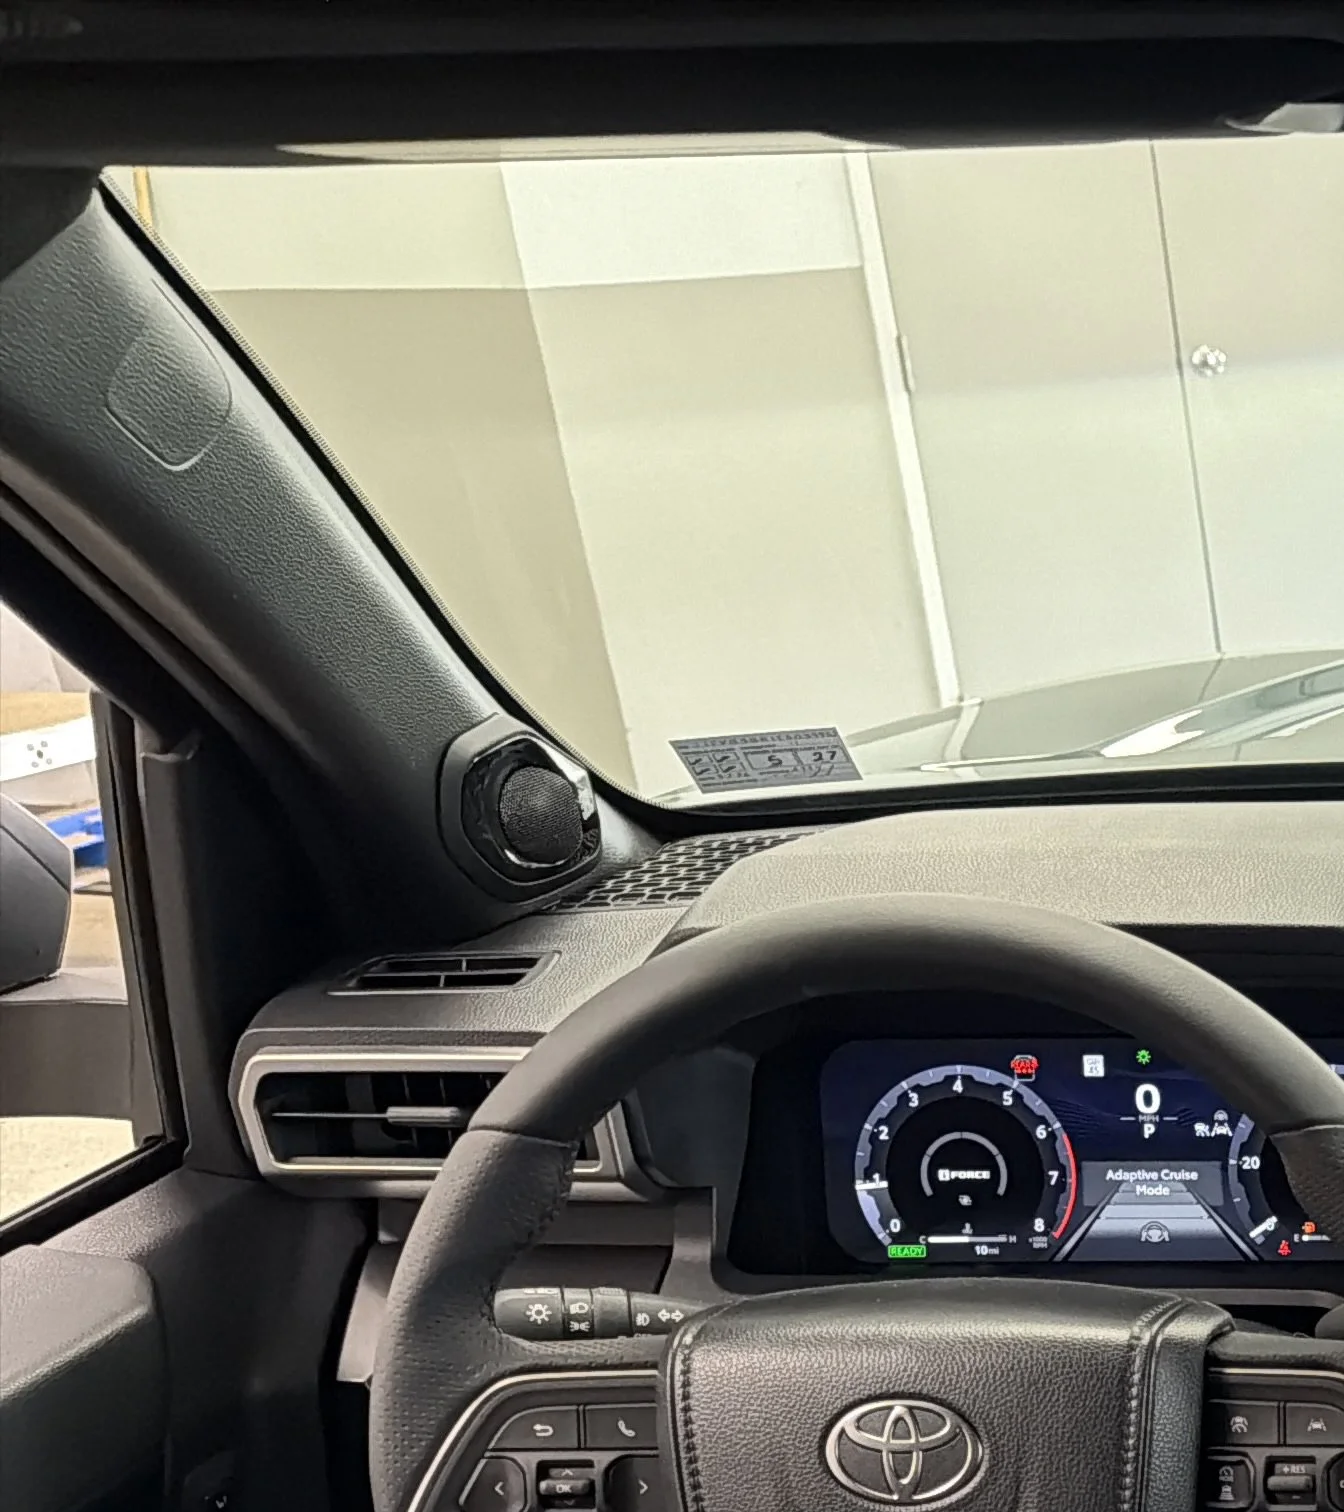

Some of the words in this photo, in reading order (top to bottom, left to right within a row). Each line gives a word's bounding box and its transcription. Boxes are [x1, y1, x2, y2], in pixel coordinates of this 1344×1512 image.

[952, 1079, 964, 1094] 4
[908, 1092, 919, 1108] 3
[1002, 1091, 1013, 1106] 5
[1134, 1083, 1161, 1114] 0
[878, 1125, 889, 1140] 2
[1035, 1127, 1047, 1139] 6
[1143, 1123, 1156, 1139] P
[1241, 1156, 1261, 1170] 20
[1048, 1170, 1059, 1185] 7
[1105, 1169, 1158, 1183] Adaptive
[1160, 1169, 1199, 1181] Cruise
[1135, 1184, 1170, 1196] Mode
[889, 1219, 901, 1232] 0
[1033, 1218, 1045, 1232] 8
[890, 1246, 924, 1257] READY
[555, 1483, 572, 1493] OK
